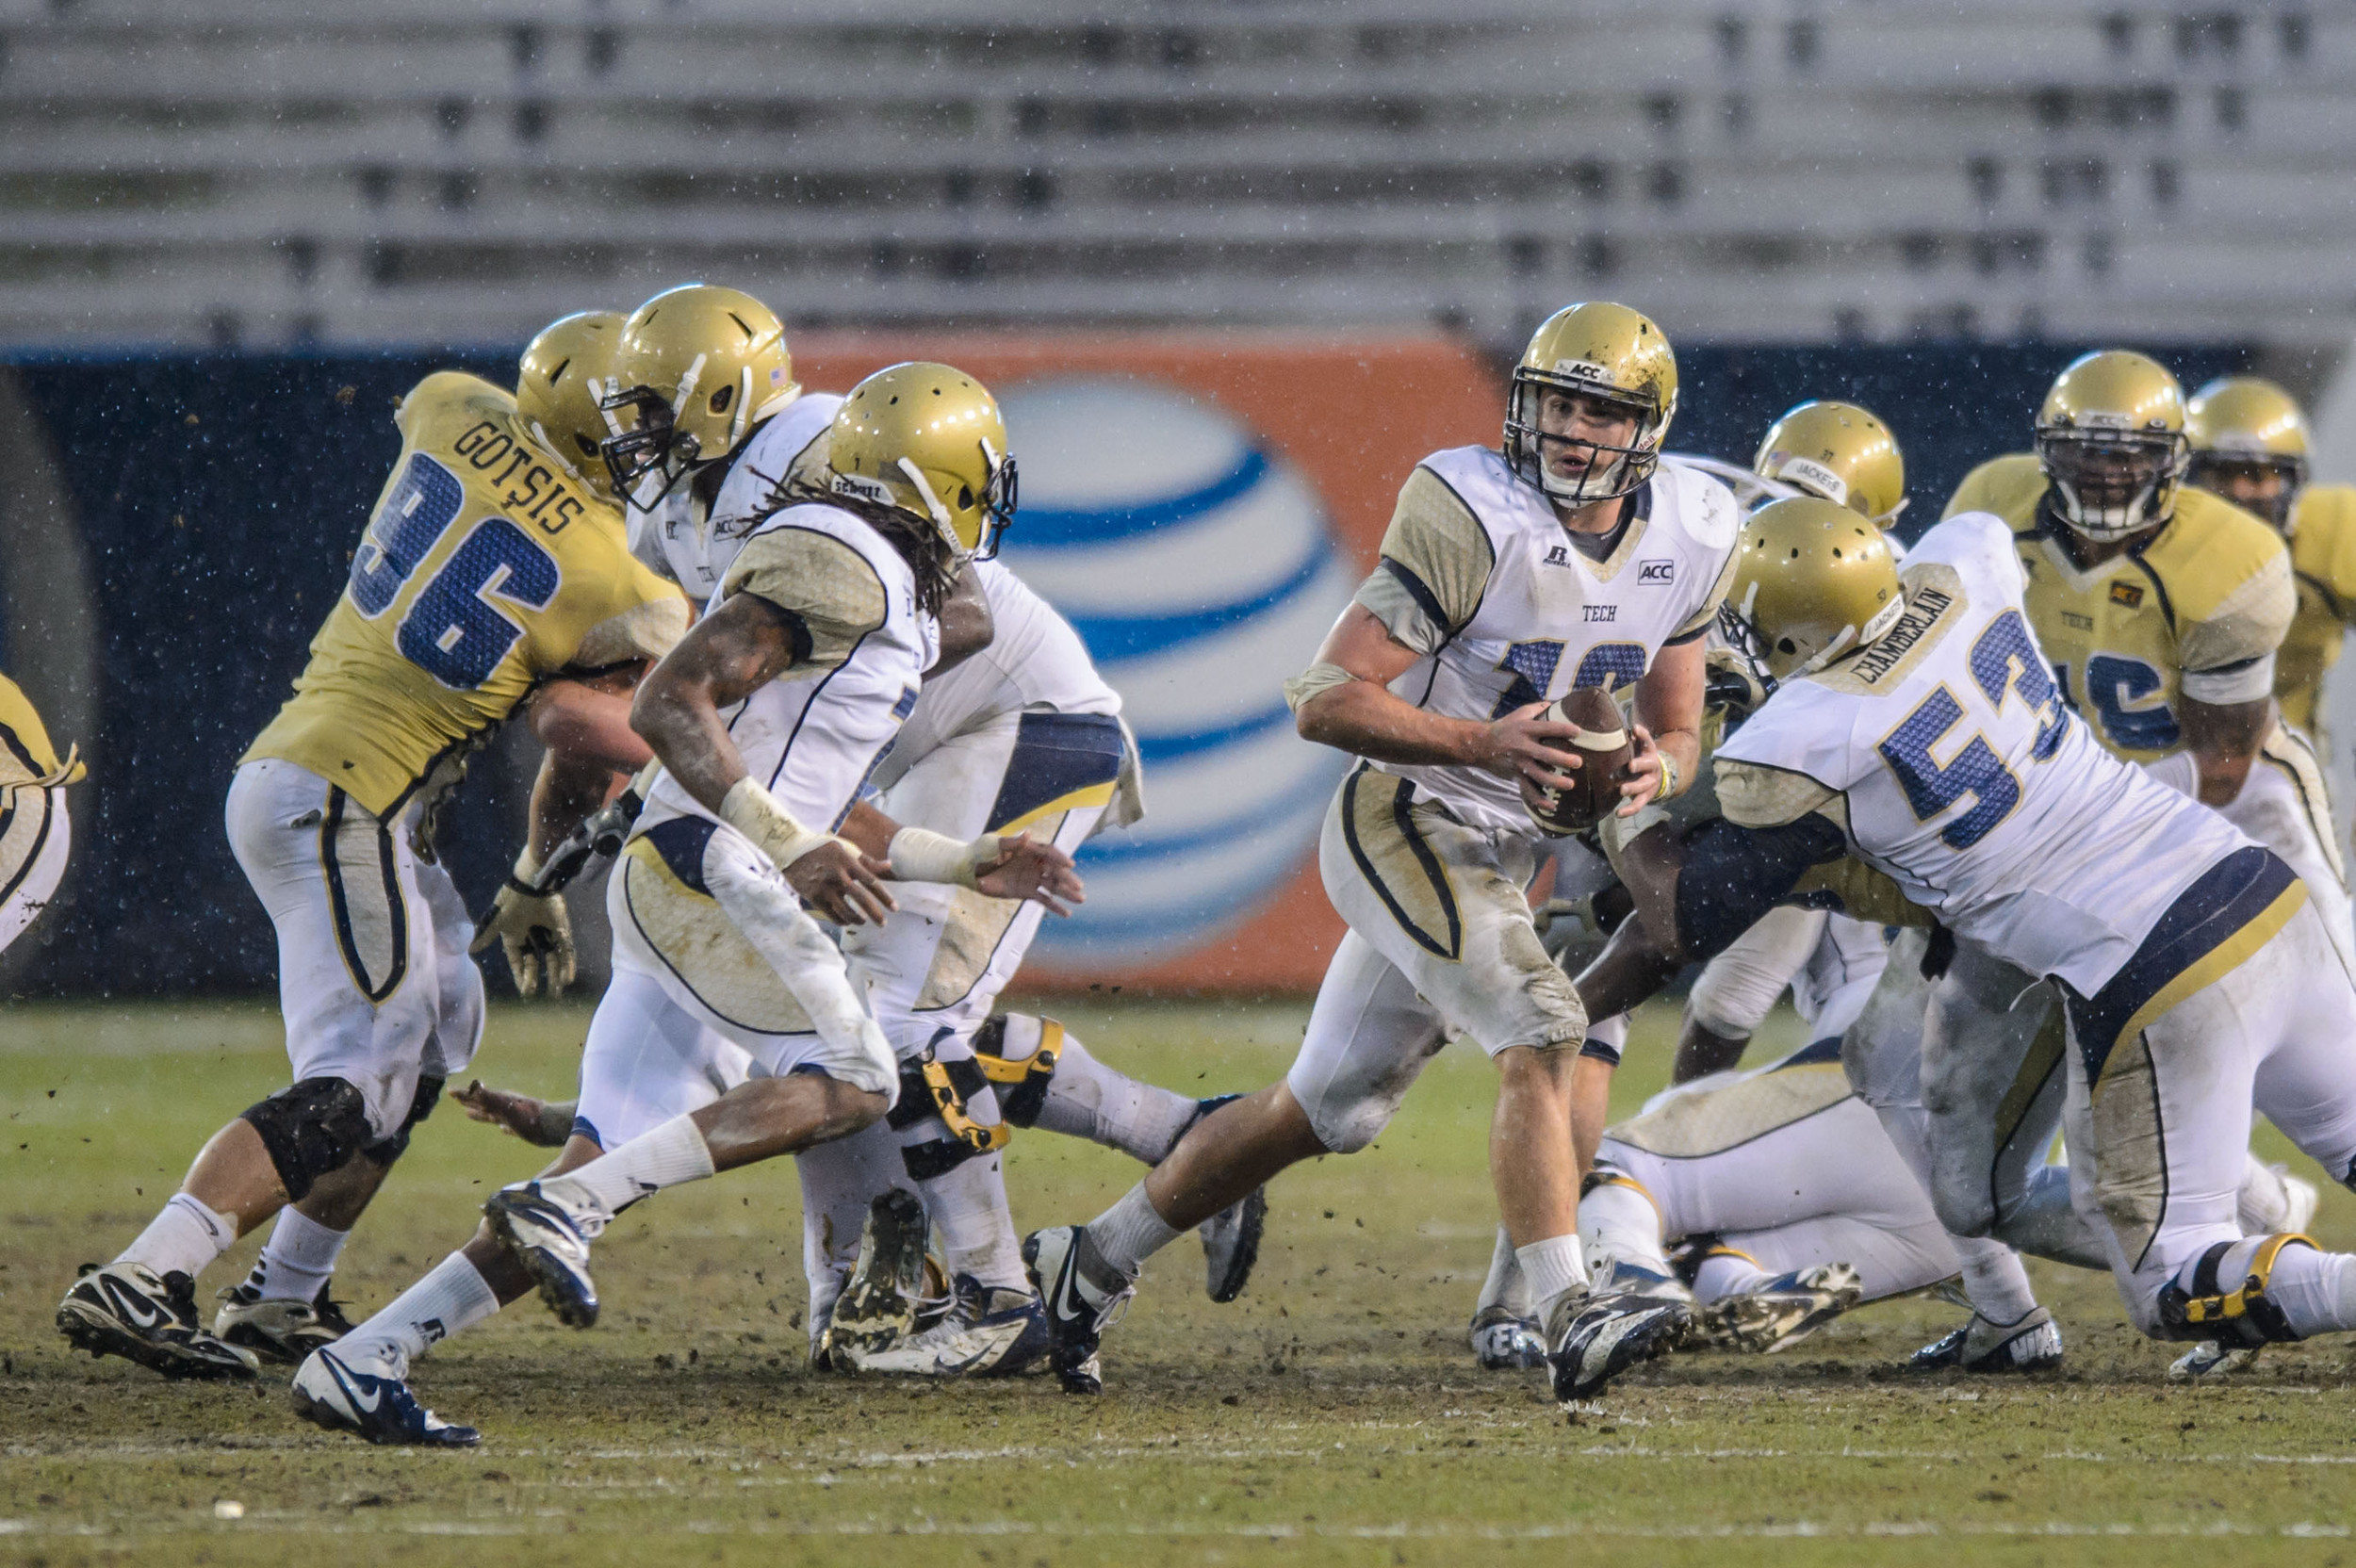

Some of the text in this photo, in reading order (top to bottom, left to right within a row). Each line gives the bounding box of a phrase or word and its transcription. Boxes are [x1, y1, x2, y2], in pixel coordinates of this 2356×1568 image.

[1570, 363, 1601, 380] ACC
[453, 420, 585, 536] GOTSIS
[1795, 463, 1841, 492] JACKETS
[348, 449, 562, 692] 96
[1639, 564, 1675, 580] ACC
[1582, 605, 1618, 622] TECH
[1849, 586, 1954, 685] CHAMBERLAIN
[1875, 605, 2074, 855] 53
